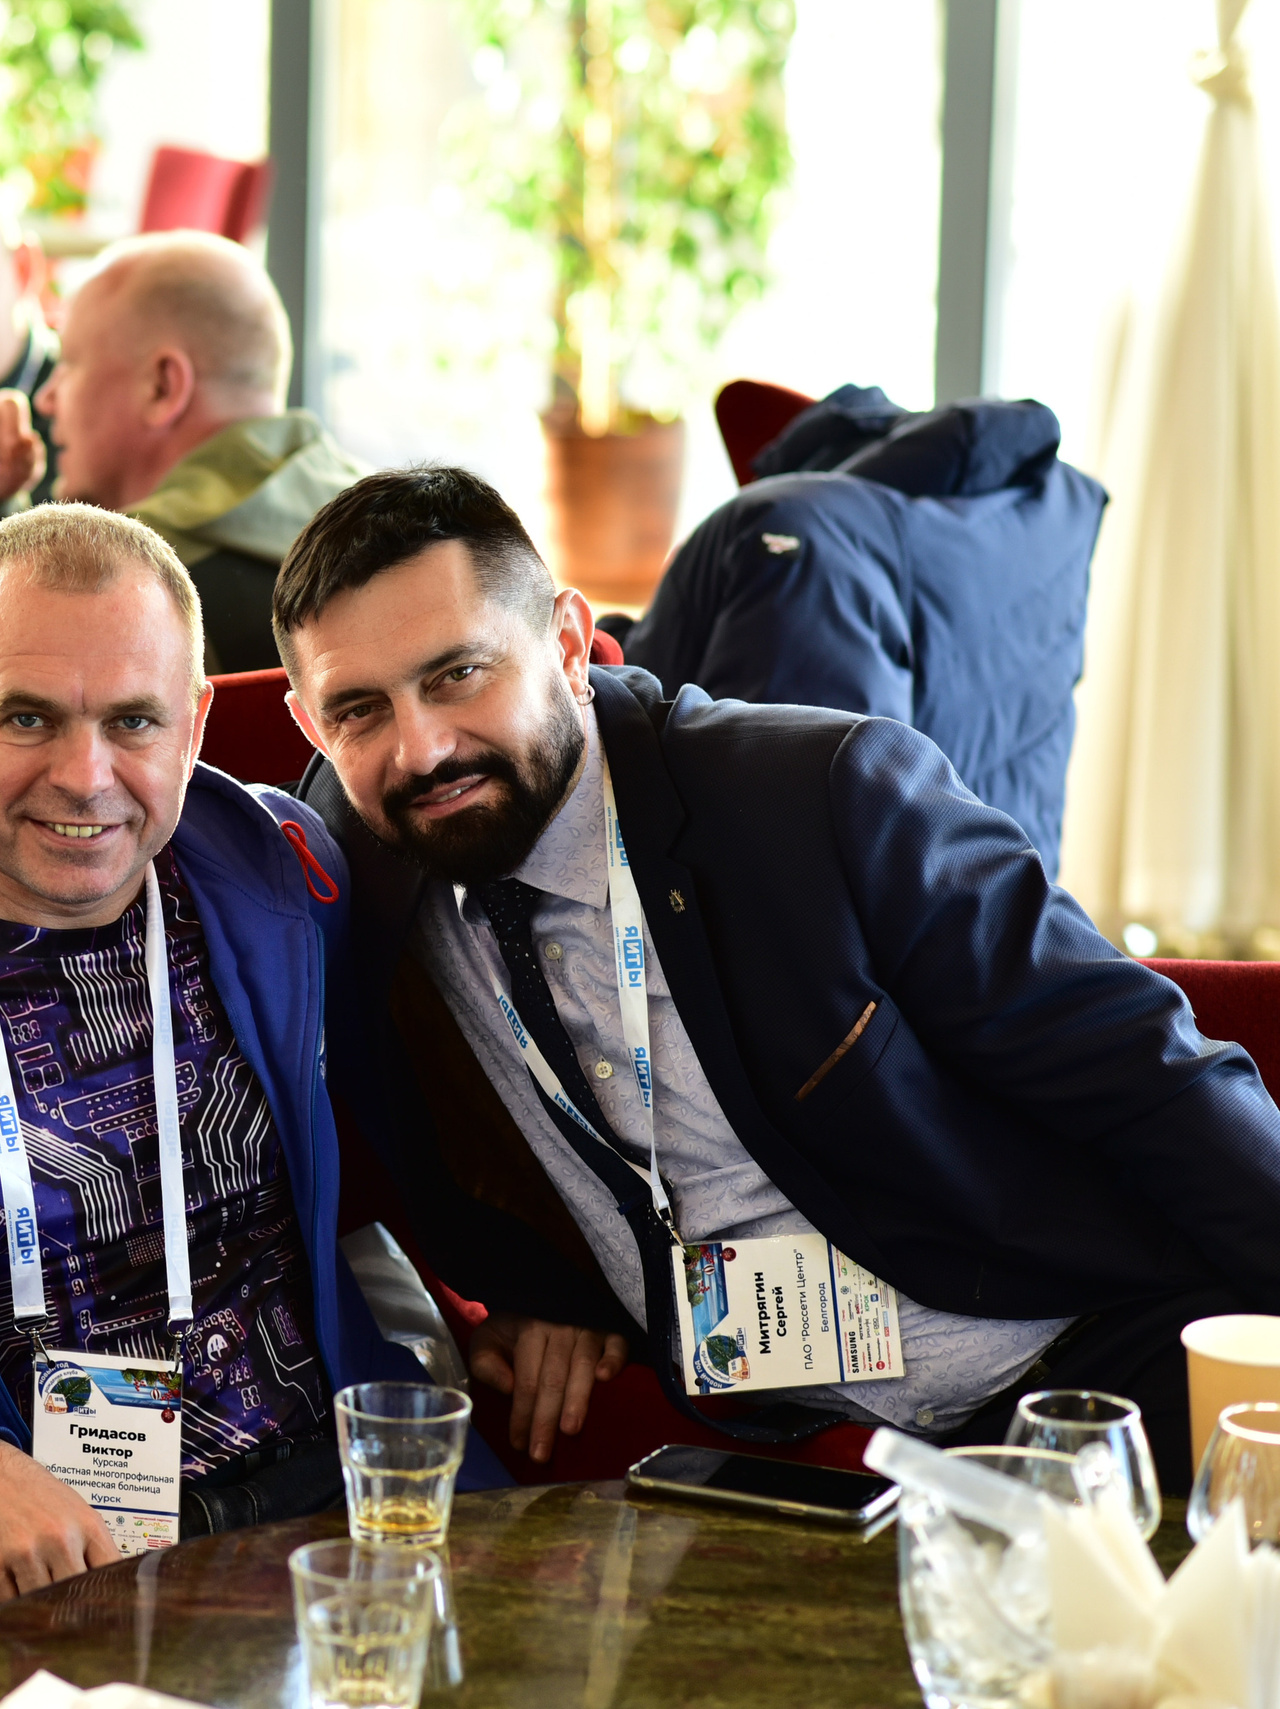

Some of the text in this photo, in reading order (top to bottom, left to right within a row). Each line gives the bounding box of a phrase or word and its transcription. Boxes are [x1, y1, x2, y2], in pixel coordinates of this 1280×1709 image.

[754, 1272, 771, 1354] Митрягин
[771, 1286, 787, 1337] Сергей
[793, 1248, 813, 1370] ПАО "Россети Центр"
[818, 1282, 829, 1332] Белгород
[849, 1331, 859, 1373] SAMSUNG
[70, 1424, 146, 1441] Гридасов
[82, 1443, 133, 1459] Виктор
[93, 1457, 128, 1468] Курская
[45, 1464, 174, 1484] областная многопрофильная
[118, 1481, 160, 1494] больница
[91, 1493, 121, 1503] Курск
